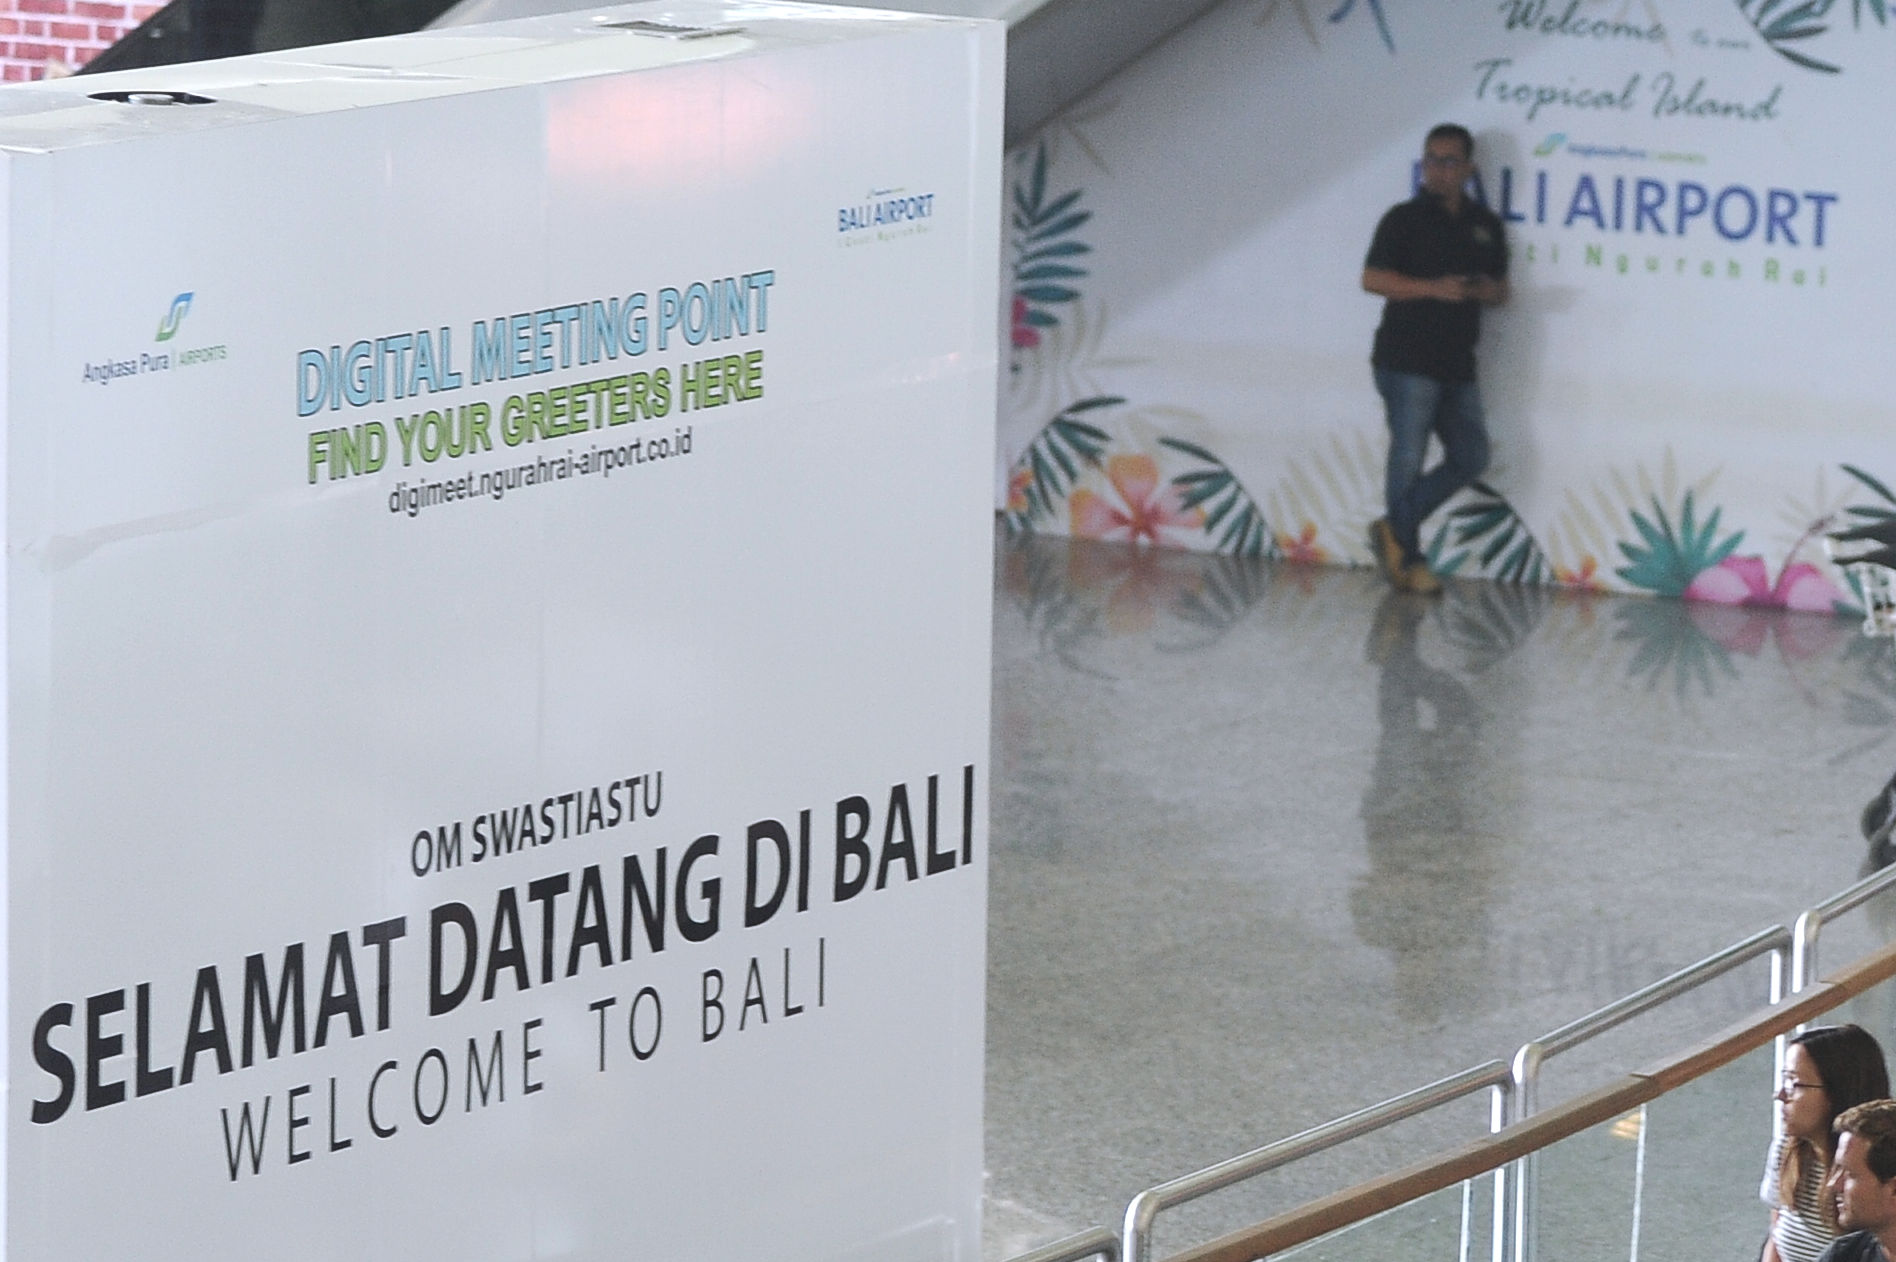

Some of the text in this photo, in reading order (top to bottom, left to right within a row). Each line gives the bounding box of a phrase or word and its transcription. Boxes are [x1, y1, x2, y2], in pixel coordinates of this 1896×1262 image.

[1473, 57, 1783, 121] Tropical Island
[838, 193, 934, 232] BALI AIRPORT
[1564, 172, 1839, 247] AIRPORT
[82, 358, 137, 386] Angkasa
[139, 352, 169, 374] Pura
[297, 269, 775, 418] DIGITAL MEETING POINT
[308, 349, 764, 484] FIND YOUR GREETERS HERE
[388, 426, 693, 518] digimeet.ngurahrai-airport.co.id
[410, 770, 663, 878] OM SWASTIASTU
[30, 764, 976, 1125] SELAMAT DATANG DI BALI
[220, 936, 826, 1182] WELCOME TO BALI
